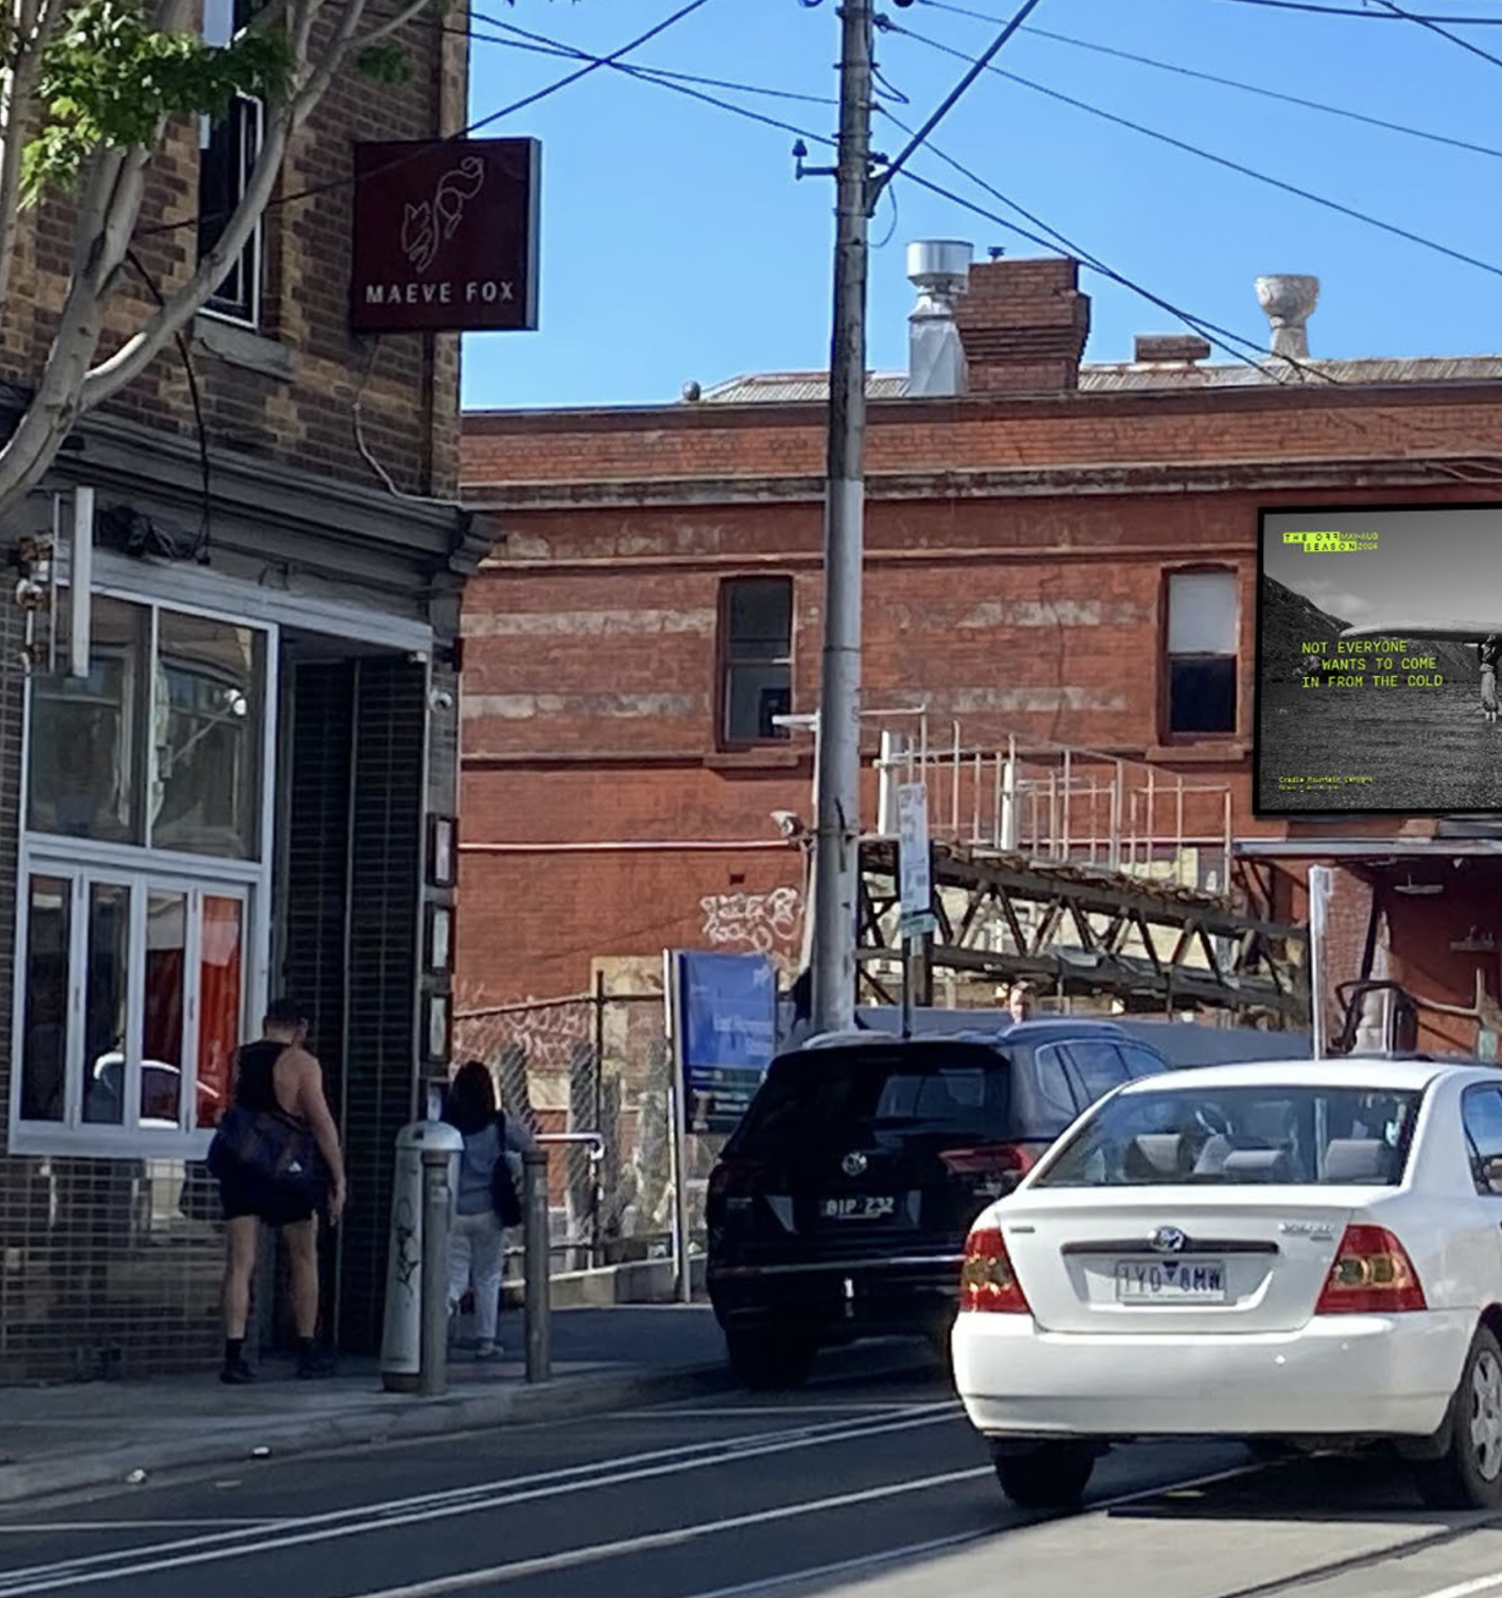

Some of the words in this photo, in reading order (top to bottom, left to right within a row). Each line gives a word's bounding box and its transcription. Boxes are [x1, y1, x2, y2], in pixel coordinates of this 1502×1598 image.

[366, 283, 451, 303] MAEVE
[465, 281, 514, 301] FOX
[1284, 533, 1308, 542] THE
[1305, 542, 1356, 551] SEASON
[1301, 641, 1328, 654] NOT
[1337, 640, 1408, 654] EVERYONE
[1321, 658, 1367, 671] WANTS
[1375, 657, 1394, 670] TO
[1401, 657, 1437, 670] COME
[1301, 676, 1320, 688] IN
[1328, 675, 1364, 688] FROM
[1372, 675, 1399, 687] THE
[1407, 674, 1443, 687] COLD
